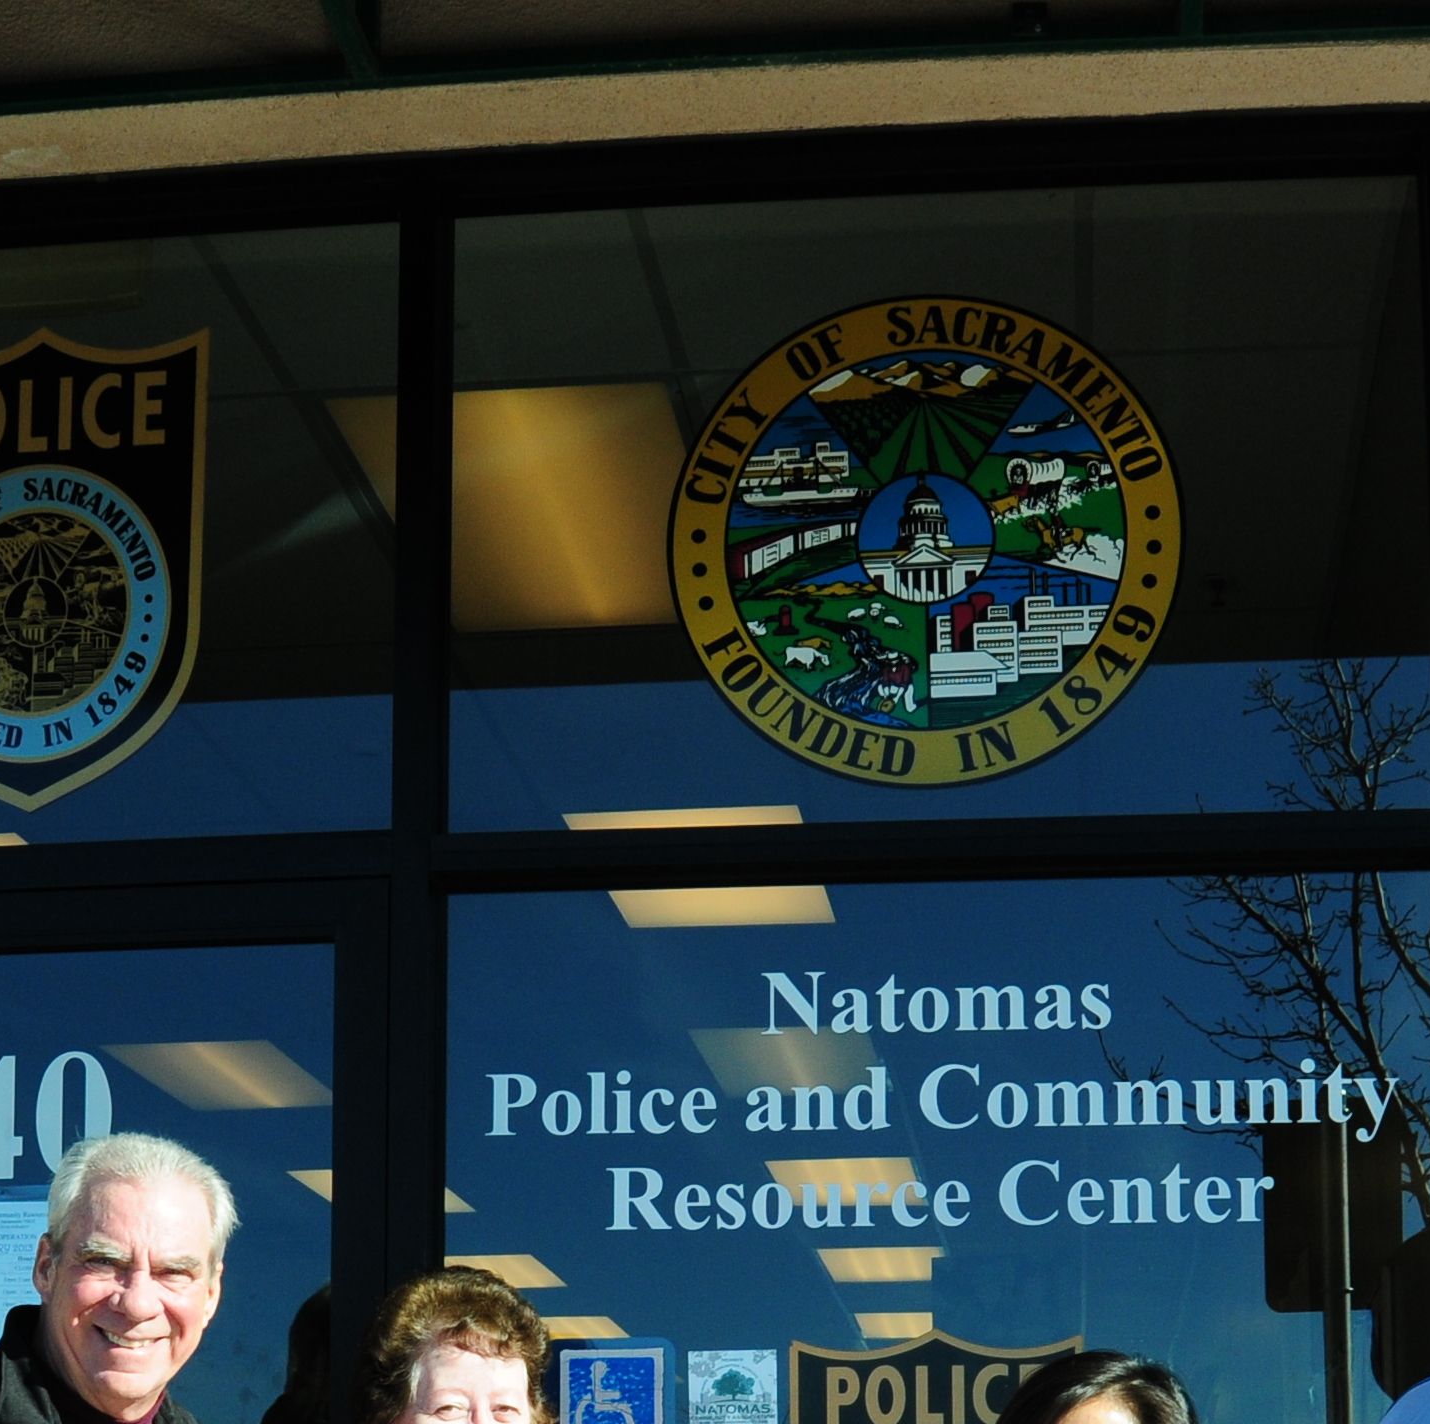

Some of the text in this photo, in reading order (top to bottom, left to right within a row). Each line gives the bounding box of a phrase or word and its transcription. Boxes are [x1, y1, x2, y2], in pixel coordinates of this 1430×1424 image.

[685, 305, 1163, 506] CITY OF SACRAMENTO
[23, 477, 157, 583] SACRAMENTO
[43, 718, 73, 749] IN
[85, 653, 147, 728] 1849
[701, 604, 1157, 777] FOUNDED IN 1849
[760, 970, 1112, 1036] Natomas
[484, 1058, 1400, 1142] Police and Community
[604, 1159, 1276, 1231] Resource Center
[695, 1404, 771, 1415] NATOMAS
